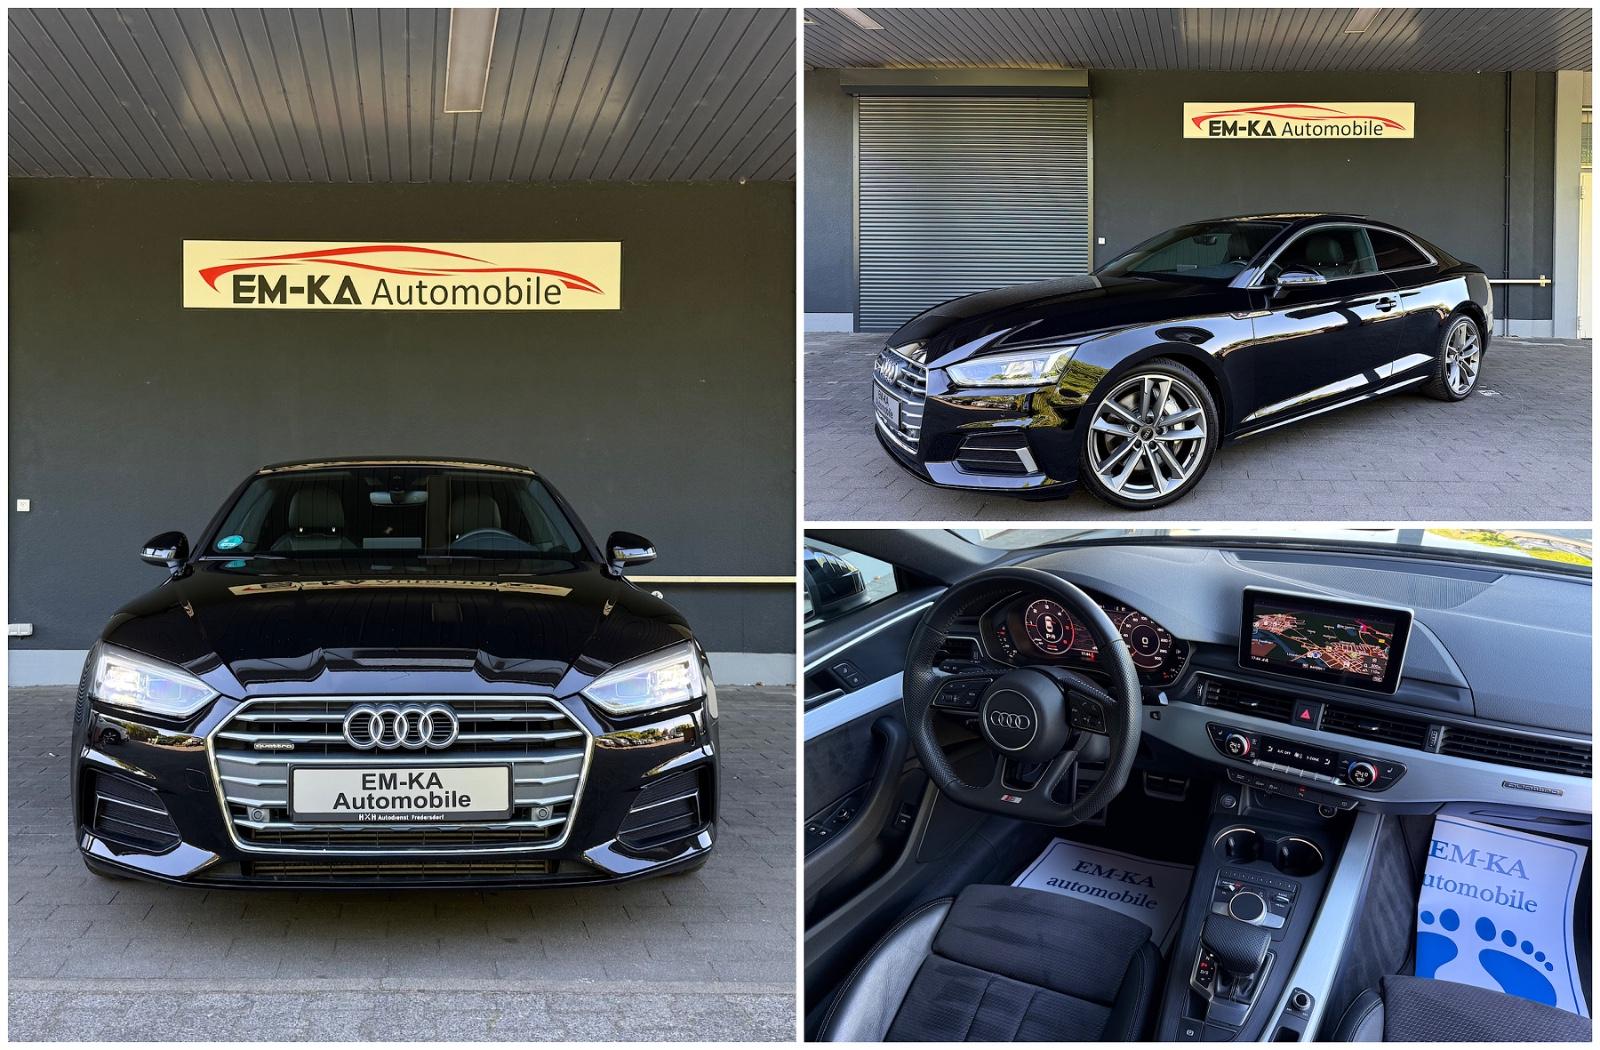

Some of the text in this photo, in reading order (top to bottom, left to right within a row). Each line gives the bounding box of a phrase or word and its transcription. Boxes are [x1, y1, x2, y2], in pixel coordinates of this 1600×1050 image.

[1209, 119, 1383, 137] EM-KA Automobile
[232, 274, 562, 306] EM-KA Automobile
[362, 772, 444, 790] EM-KA
[333, 791, 471, 810] Automobile
[1072, 859, 1156, 889] EM-KA
[1428, 839, 1530, 880] EM-KA
[1046, 876, 1158, 911] automobile
[1422, 872, 1538, 913] utomobile
